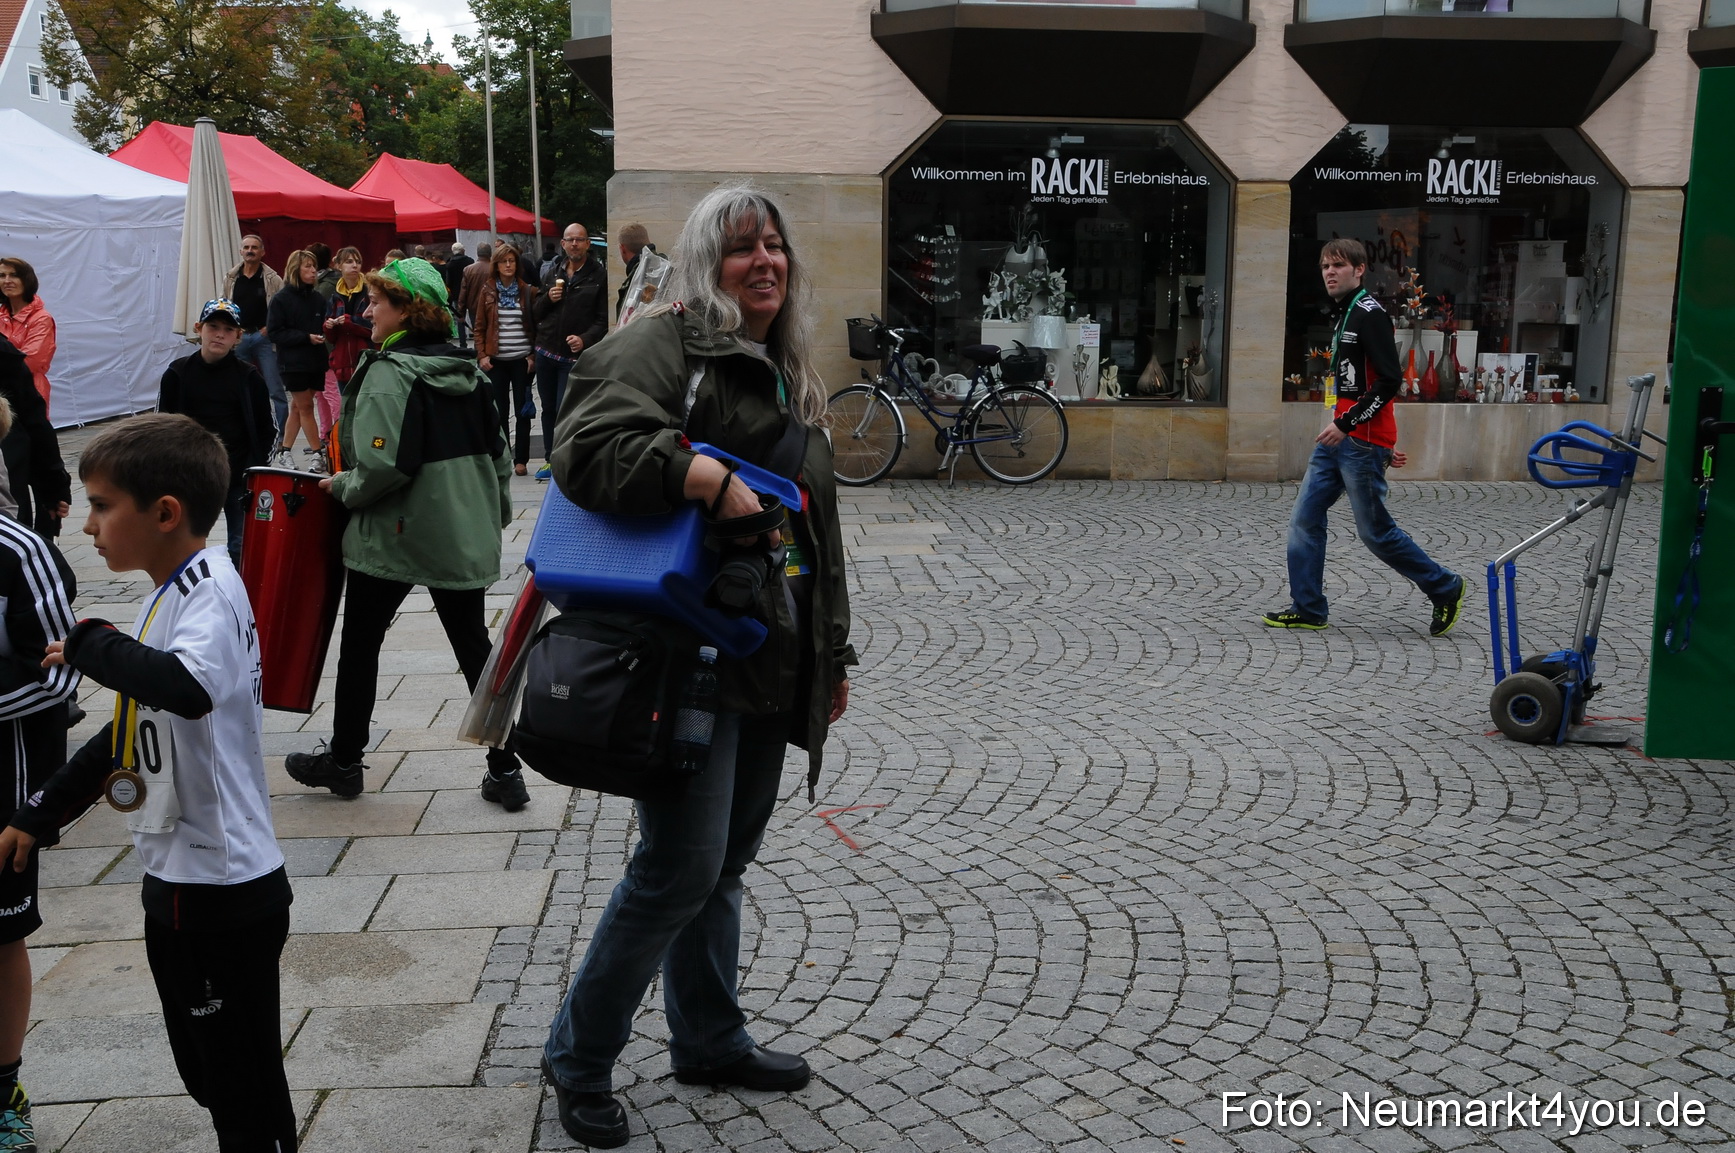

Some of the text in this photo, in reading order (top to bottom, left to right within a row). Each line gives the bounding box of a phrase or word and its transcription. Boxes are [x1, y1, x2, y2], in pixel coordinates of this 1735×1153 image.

[911, 166, 1026, 182] Willkommen im
[1030, 157, 1108, 195] RACKL
[1114, 171, 1211, 186] Erlebnishaus.
[1314, 167, 1423, 182] Willkommen im
[1426, 158, 1500, 195] RACKL
[1506, 171, 1599, 185] Erlebnishaus.
[1030, 195, 1055, 203] Jeden
[1056, 195, 1071, 205] Tag
[1425, 195, 1449, 203] Jeden
[1450, 195, 1464, 205] Tag
[0, 902, 28, 917] JAKO
[190, 1005, 217, 1017] JAKO
